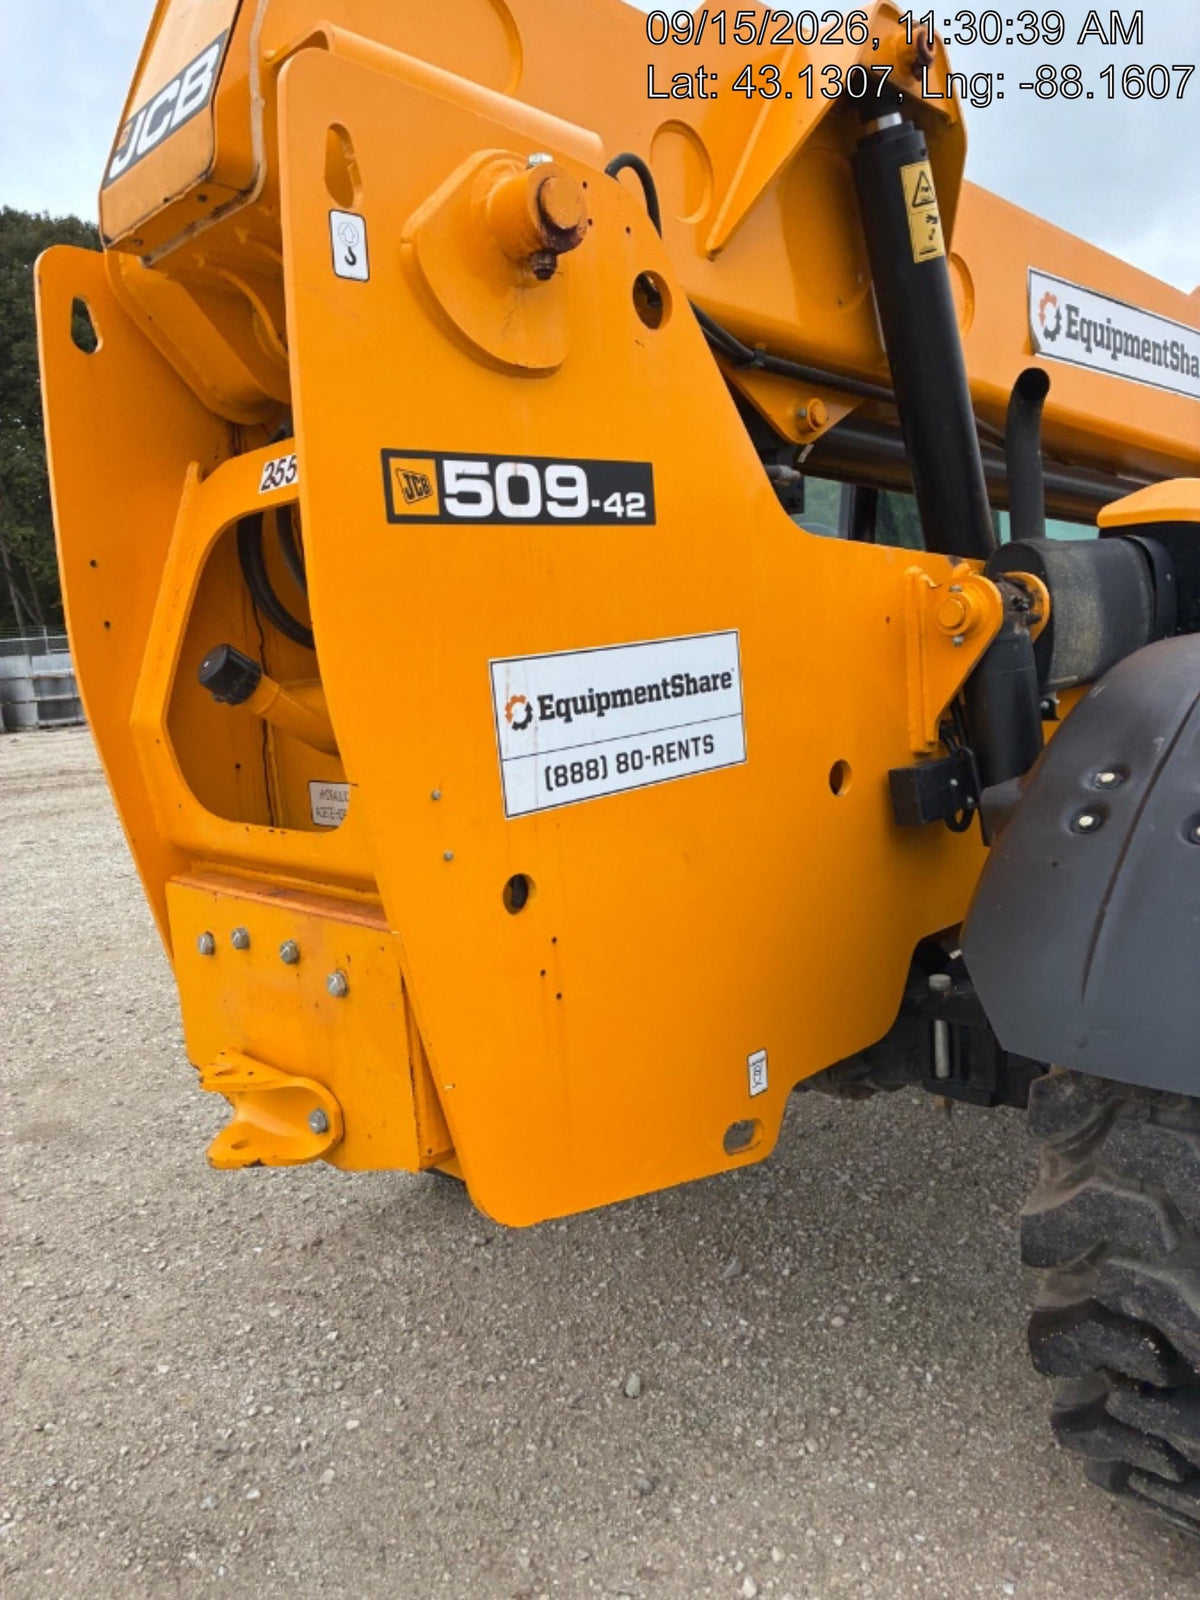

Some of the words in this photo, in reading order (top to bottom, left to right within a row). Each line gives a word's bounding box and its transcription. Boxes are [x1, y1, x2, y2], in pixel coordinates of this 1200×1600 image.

[109, 43, 220, 179] JCB
[402, 472, 431, 500] JCB
[537, 670, 733, 723] EquipmentShare
[545, 755, 608, 791] (888)
[616, 733, 715, 774] 80-RENTS
